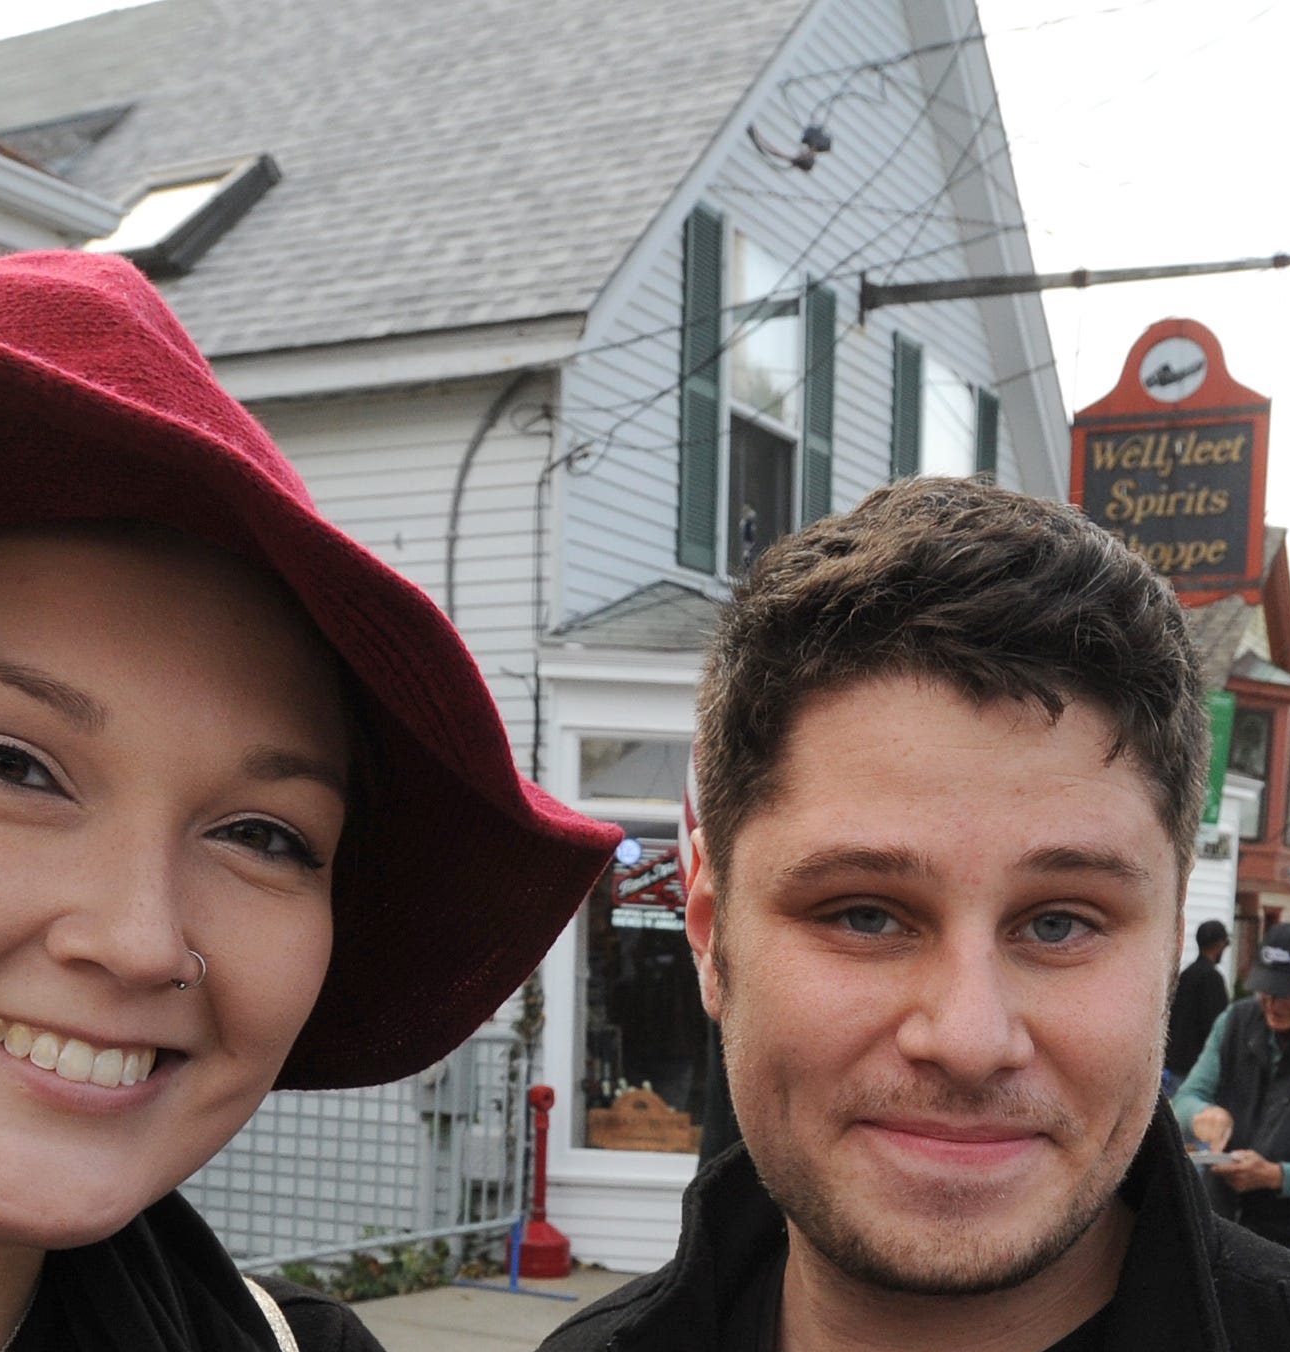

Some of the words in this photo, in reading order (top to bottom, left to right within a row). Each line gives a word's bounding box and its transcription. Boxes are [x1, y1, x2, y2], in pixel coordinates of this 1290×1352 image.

[1091, 431, 1245, 478] Wellfleet
[1105, 478, 1229, 525] Spirits
[1112, 529, 1228, 572] hoppe
